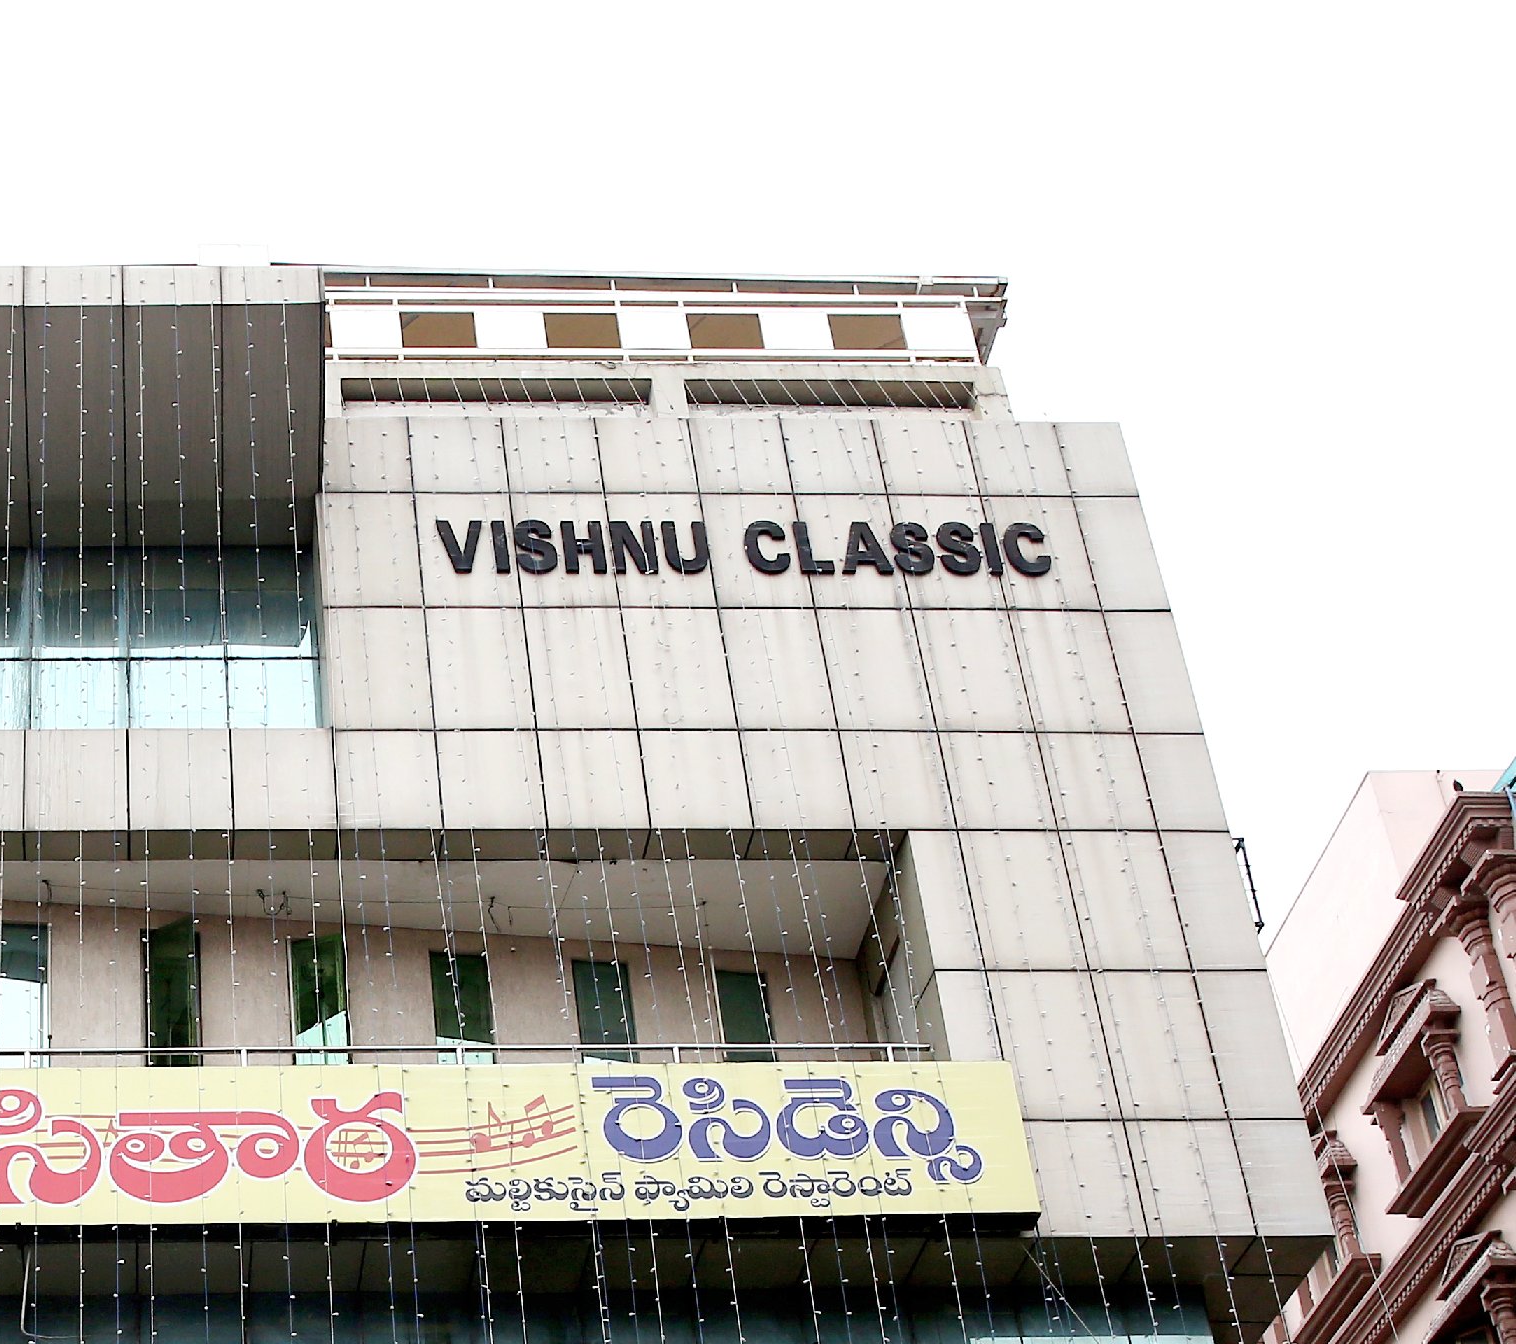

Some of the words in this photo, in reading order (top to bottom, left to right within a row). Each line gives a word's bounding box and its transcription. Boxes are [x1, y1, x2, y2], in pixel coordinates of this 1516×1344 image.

[436, 519, 710, 575] VISHNU
[743, 520, 1053, 577] CLASSIC
[590, 1075, 984, 1185] రెసిడెన్సి
[465, 1171, 626, 1212] మల్టికుసైన్
[634, 1174, 755, 1212] ఫ్యామిలి
[758, 1167, 913, 1208] రెస్టారెంట్
